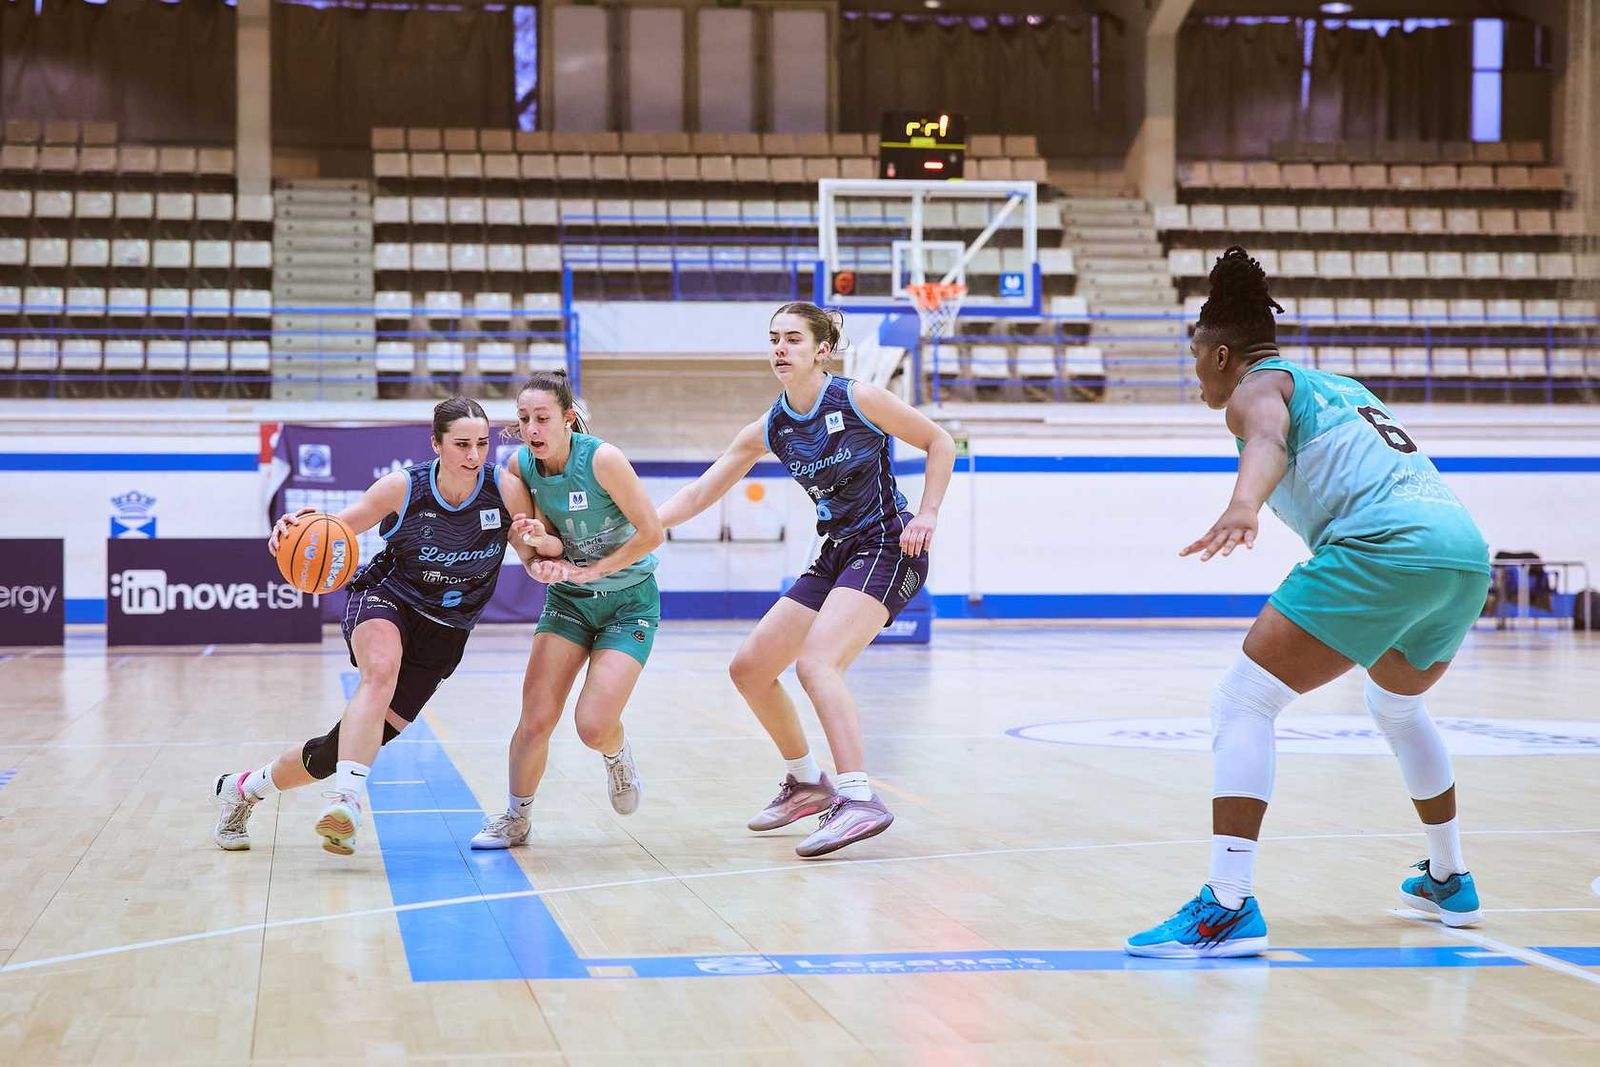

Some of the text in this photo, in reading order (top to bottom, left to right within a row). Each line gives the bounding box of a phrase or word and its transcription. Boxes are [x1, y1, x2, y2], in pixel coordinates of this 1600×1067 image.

[1357, 406, 1418, 454] 6
[789, 447, 852, 479] Leganés
[418, 543, 501, 567] Leganés
